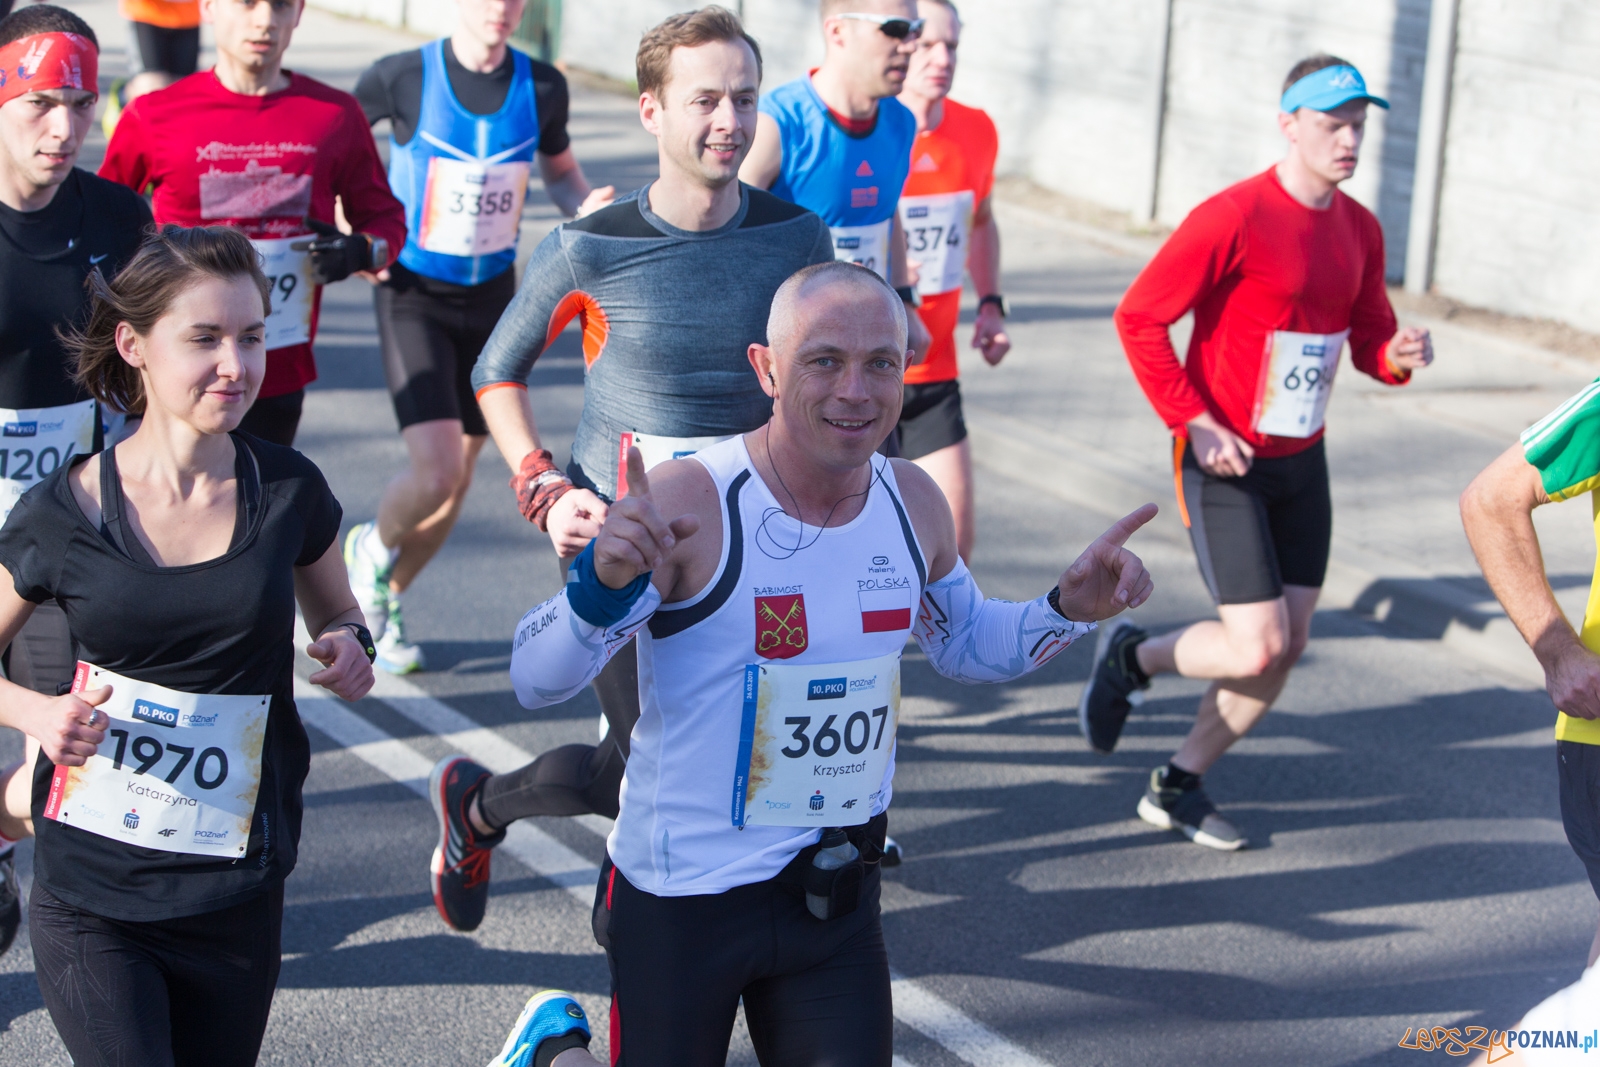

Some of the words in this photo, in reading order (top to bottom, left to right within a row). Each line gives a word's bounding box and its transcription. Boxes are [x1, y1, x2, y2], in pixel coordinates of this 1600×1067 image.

[450, 190, 513, 217] 3358
[868, 566, 896, 574] Kalenji
[753, 585, 803, 596] BABIMOST
[857, 577, 910, 591] POLSKA
[746, 670, 754, 699] 26.03.2017
[812, 685, 825, 694] 10.
[825, 683, 844, 694] PKO
[138, 704, 151, 717] 10.
[151, 708, 175, 725] PKO
[781, 705, 889, 759] 3607
[110, 728, 229, 791] 1970
[813, 760, 867, 778] Krzysztof
[127, 781, 197, 808] Katarzyna
[842, 799, 858, 809] 4F
[158, 829, 178, 837] 4F
